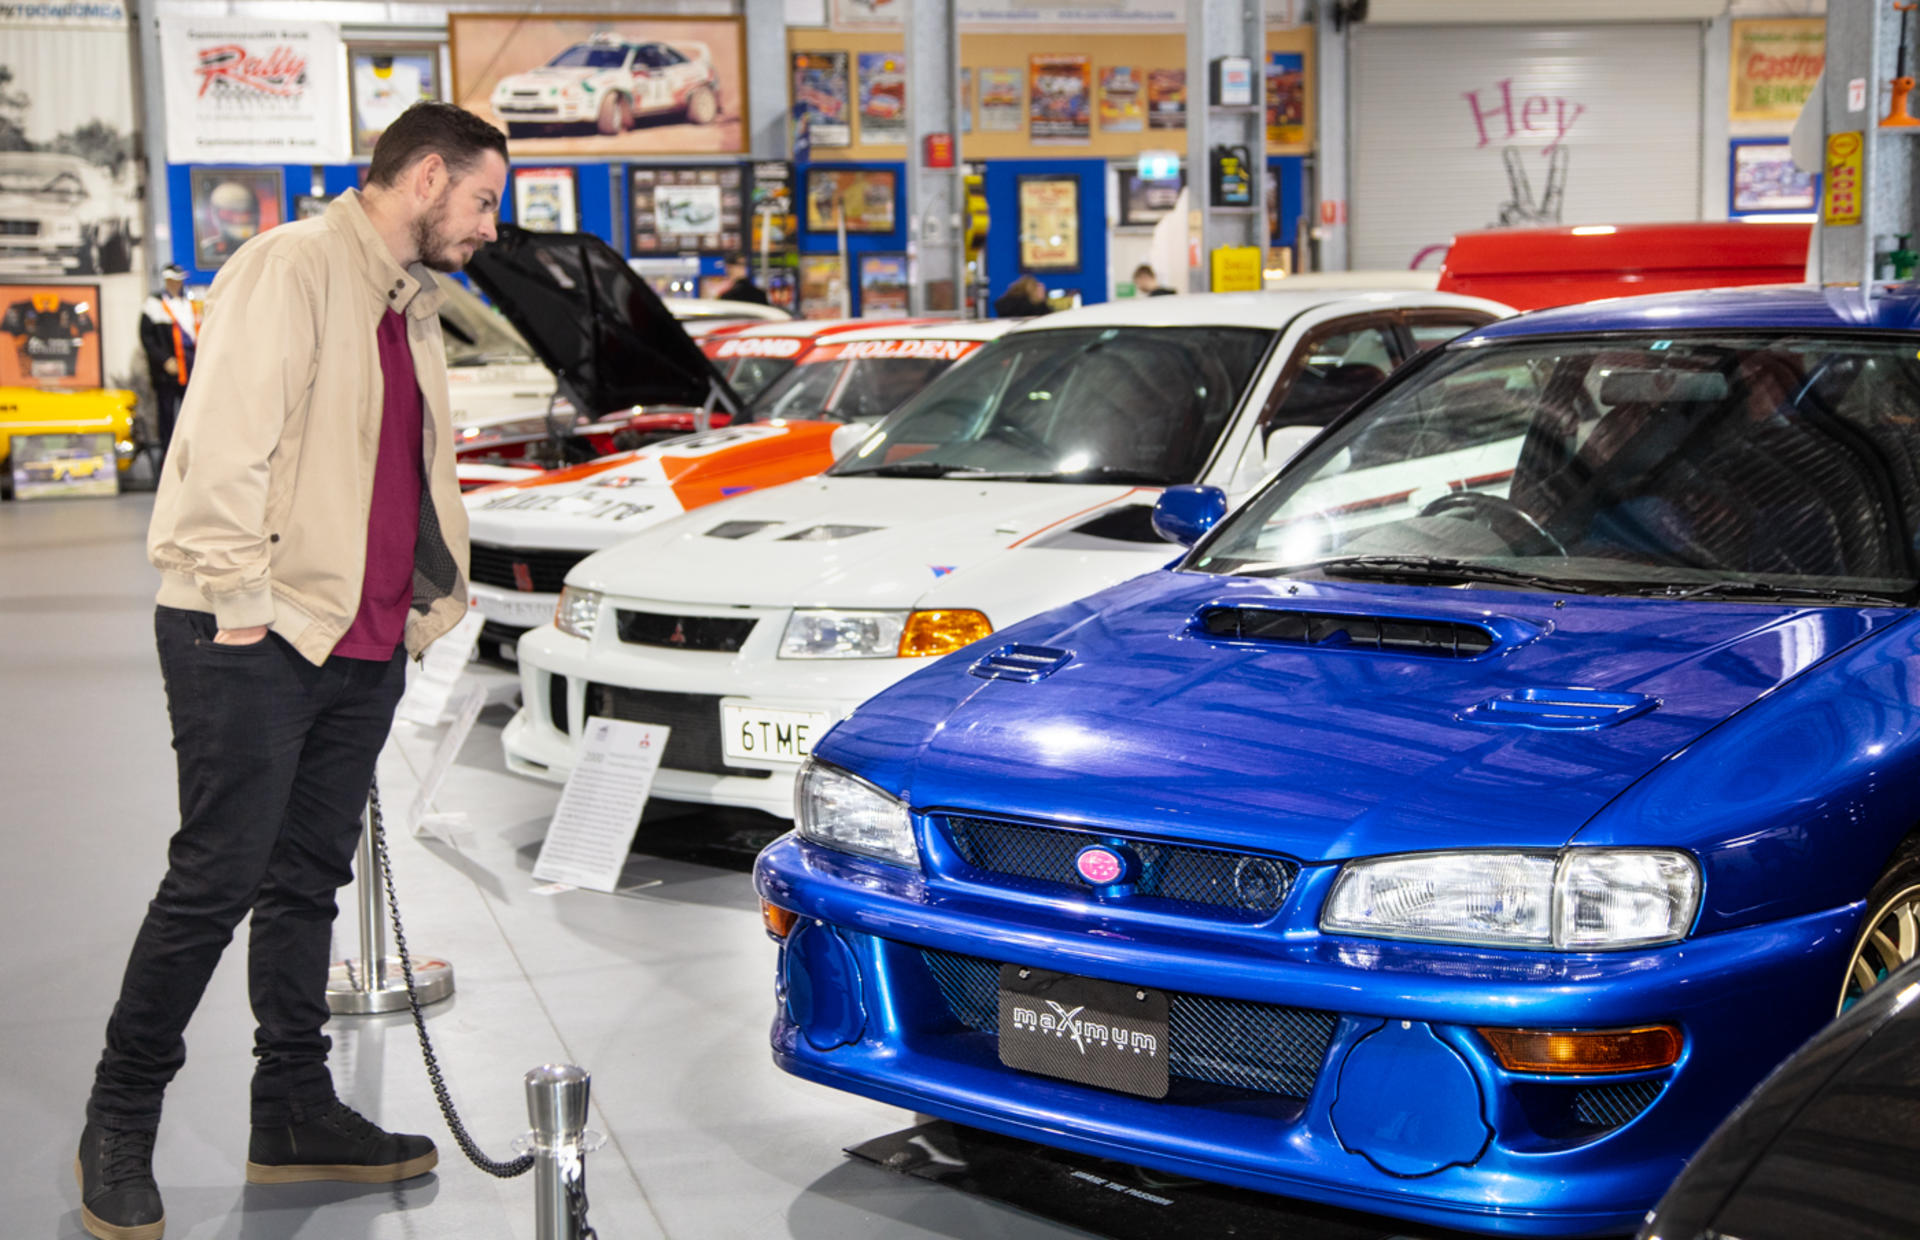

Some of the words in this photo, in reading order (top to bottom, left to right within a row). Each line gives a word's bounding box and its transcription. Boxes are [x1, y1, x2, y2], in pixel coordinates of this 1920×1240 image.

[194, 44, 306, 99] Rally
[1753, 86, 1813, 105] SERVIC
[1461, 78, 1585, 156] Hey
[716, 338, 802, 358] BOND
[836, 340, 971, 360] HOLDEN
[741, 720, 809, 756] 6TME
